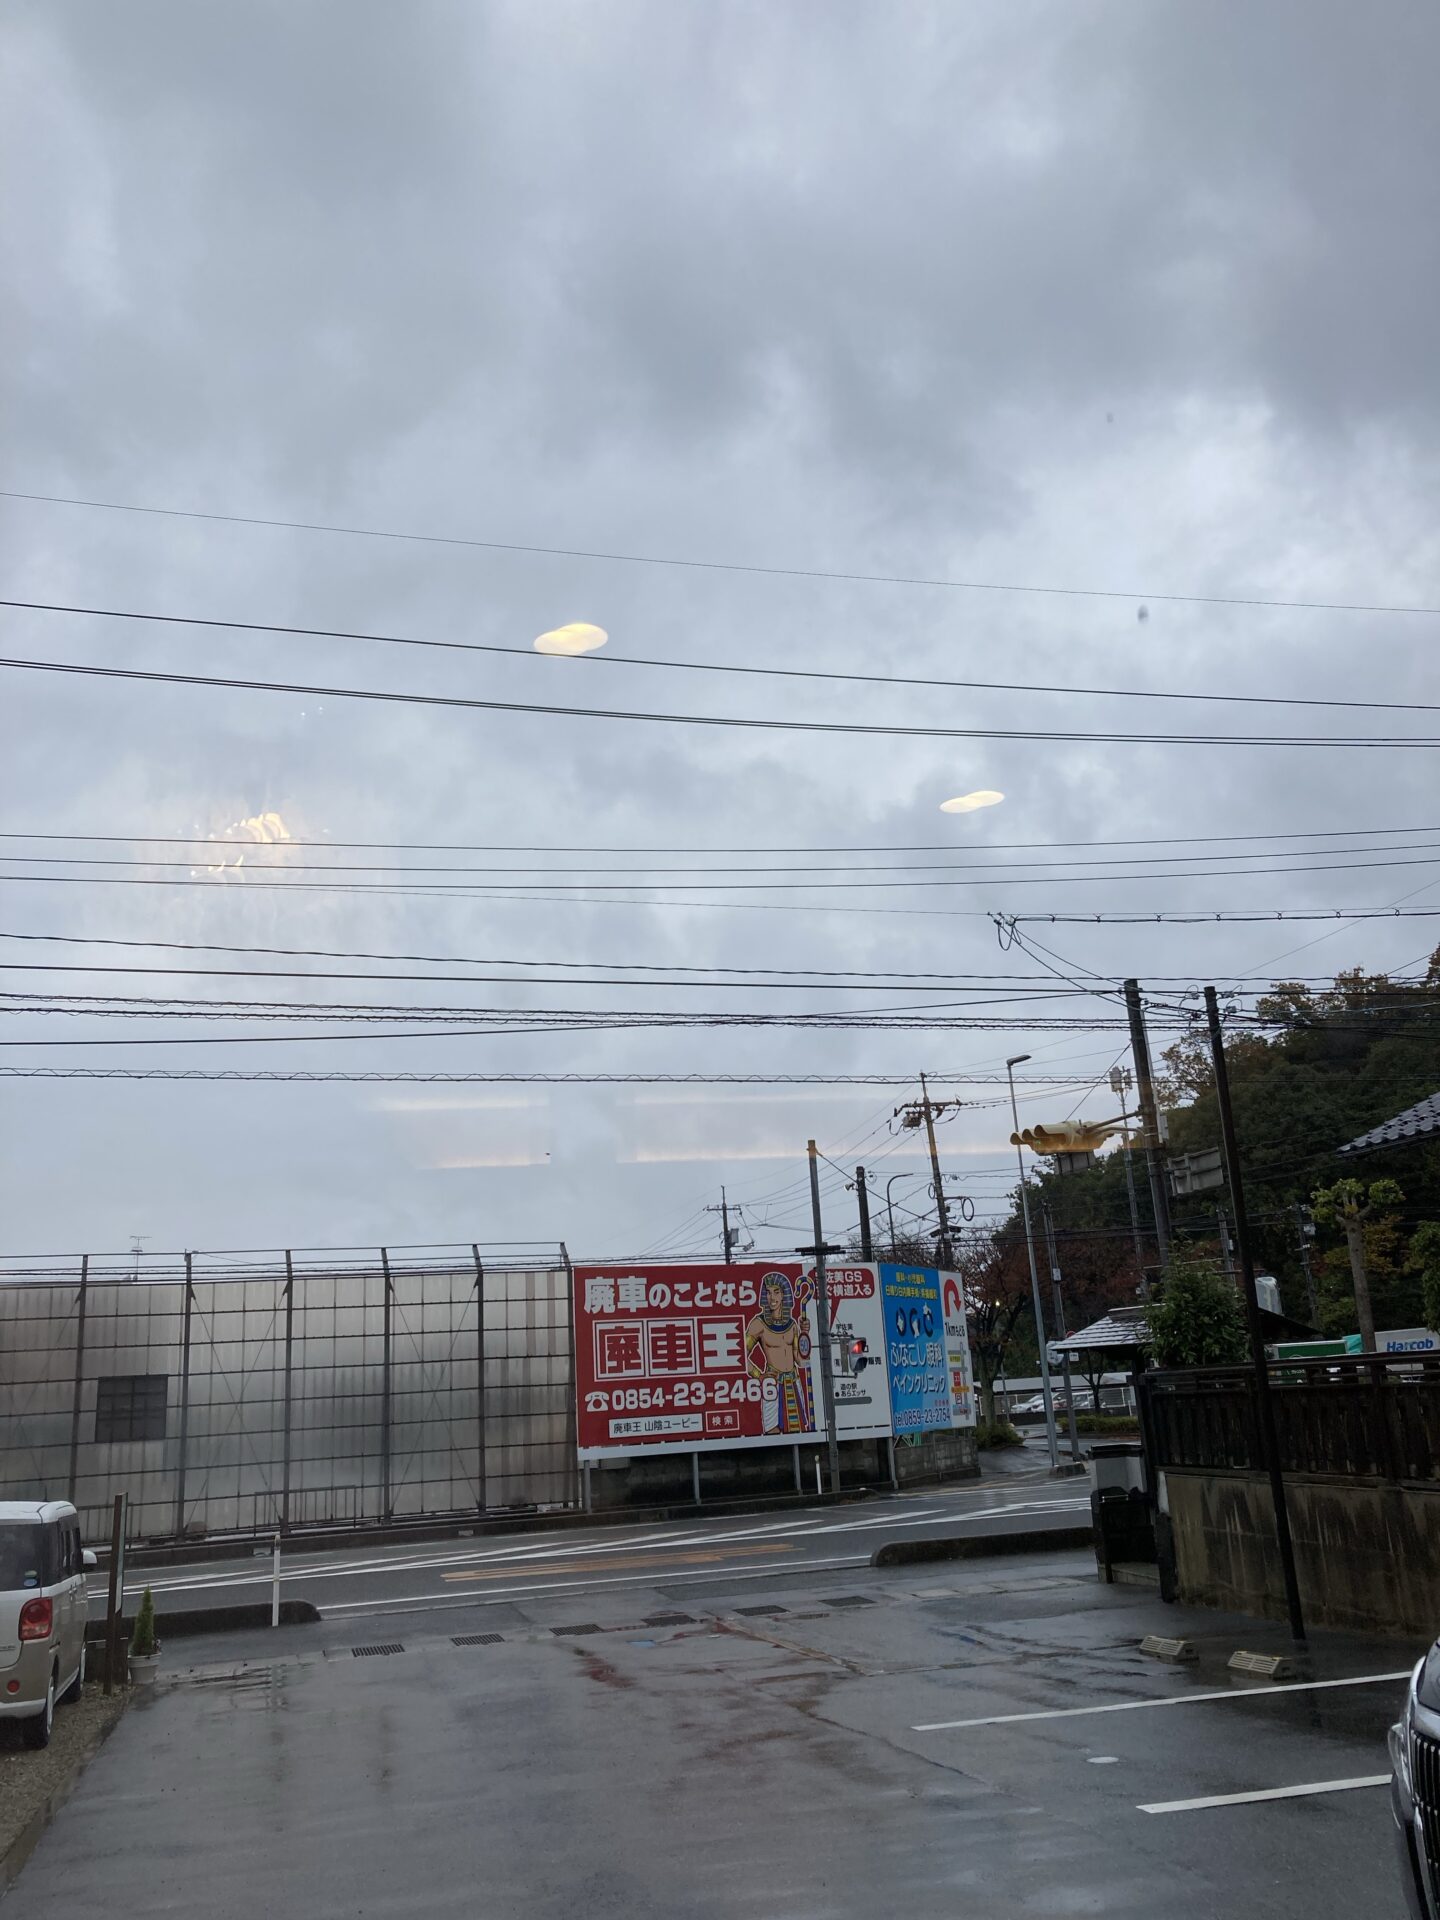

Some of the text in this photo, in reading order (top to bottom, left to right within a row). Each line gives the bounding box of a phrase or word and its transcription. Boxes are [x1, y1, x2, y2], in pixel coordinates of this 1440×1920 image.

[815, 1271, 862, 1283] 佐美GS
[584, 1276, 757, 1314] 廃車のことなら
[815, 1284, 871, 1296] ぐ横道入る
[594, 1318, 744, 1379] 廃車王
[891, 1342, 944, 1368] ふなこし眼科
[612, 1377, 778, 1411] 0854-23-2466
[893, 1374, 945, 1394] ペインクリニック
[613, 1422, 641, 1434] 廃車王
[712, 1416, 734, 1427] 検索
